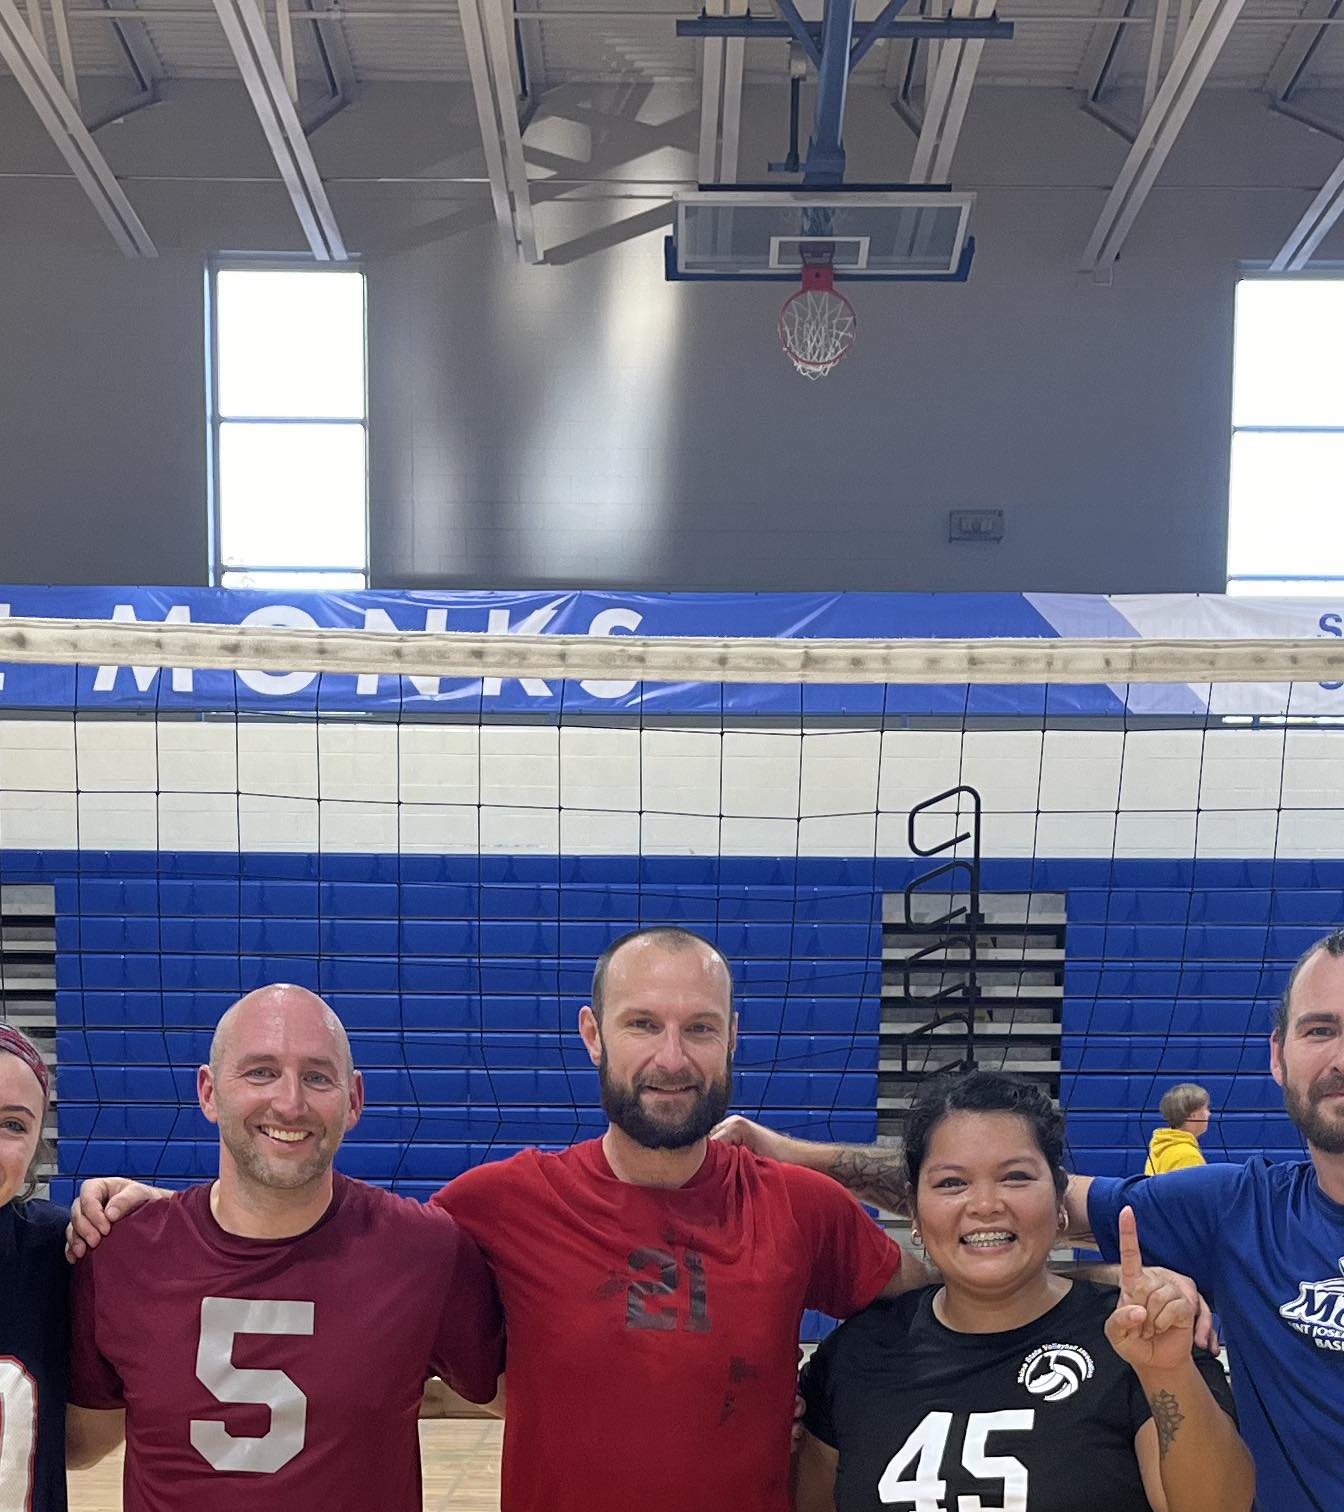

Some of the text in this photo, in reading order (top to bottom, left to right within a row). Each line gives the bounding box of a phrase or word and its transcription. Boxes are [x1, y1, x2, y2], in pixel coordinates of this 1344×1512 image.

[94, 604, 644, 700] MONKS
[626, 1247, 712, 1333] 21
[190, 1297, 315, 1474] 5
